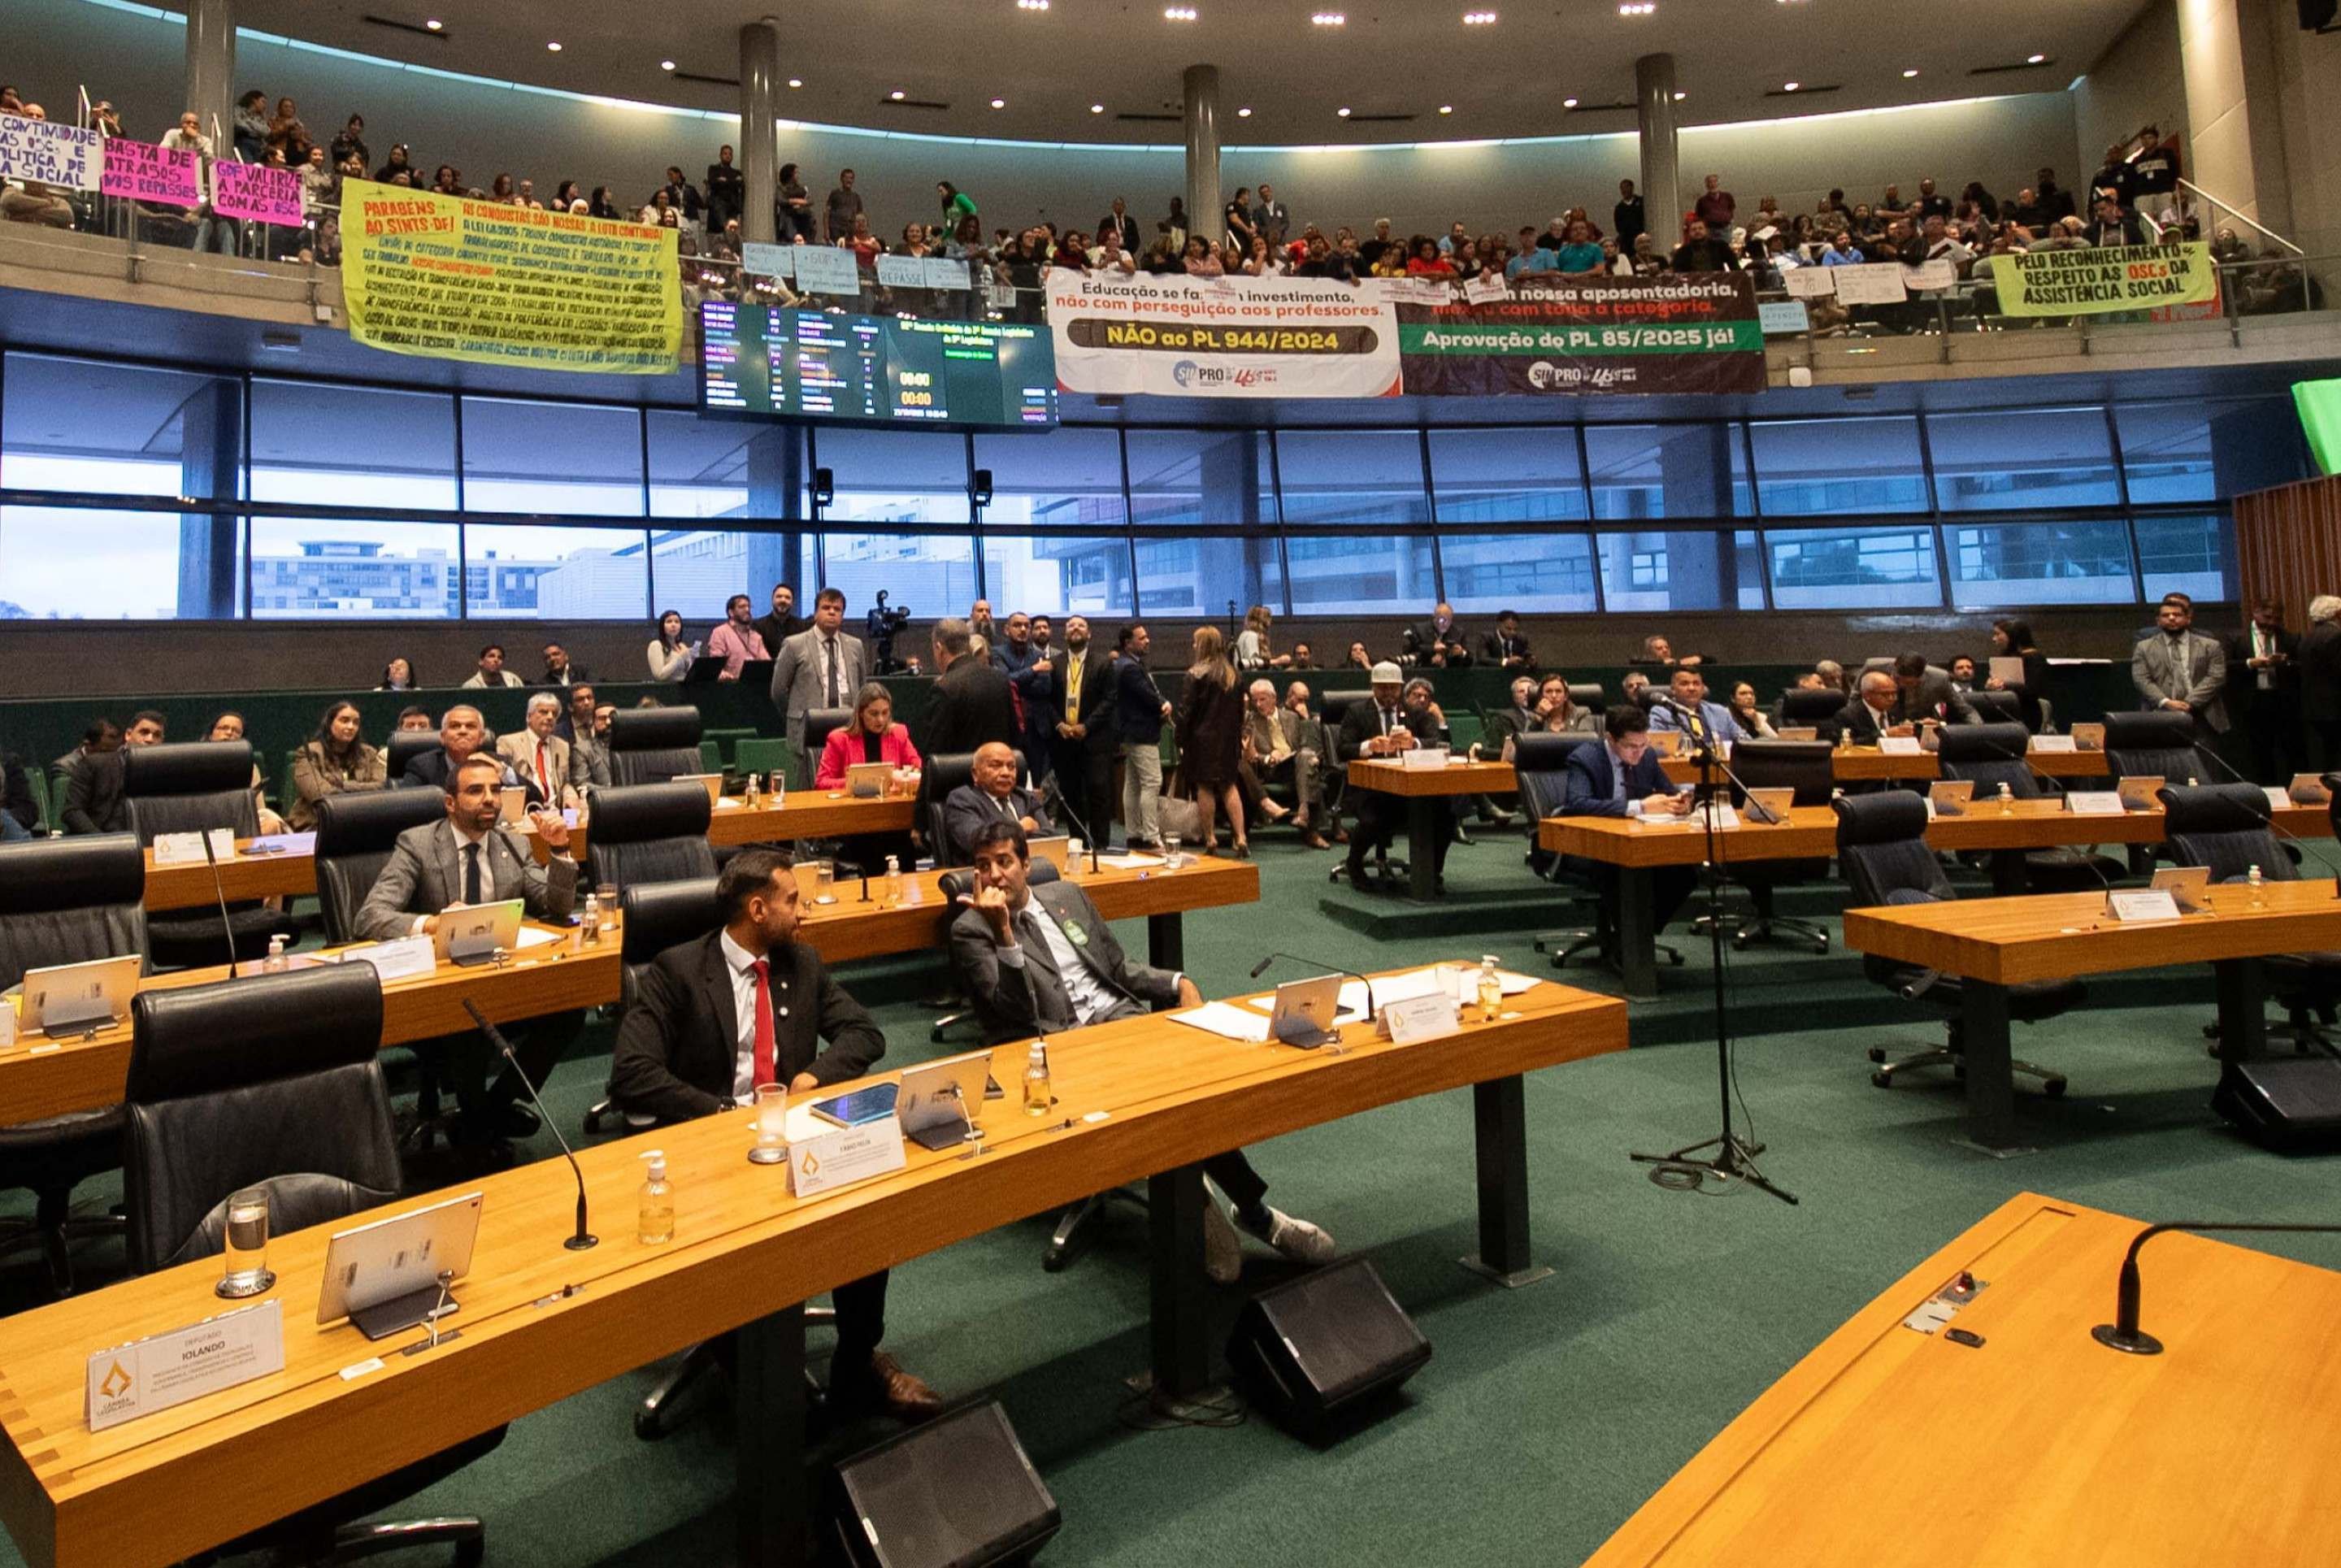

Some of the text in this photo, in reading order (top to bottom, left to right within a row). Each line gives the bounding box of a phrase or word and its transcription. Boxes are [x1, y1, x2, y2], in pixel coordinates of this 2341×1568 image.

[2, 117, 97, 146] CONTINUIDADE
[75, 145, 85, 158] E
[105, 138, 192, 167] BASTA DE
[21, 163, 85, 186] SOCIAL
[67, 159, 85, 173] DE
[105, 156, 182, 183] ATRASOS
[217, 162, 242, 178] GDF
[105, 174, 197, 199] NOS REPASSES
[218, 178, 300, 203] A PARCERIA
[218, 194, 247, 210] COM
[250, 198, 268, 212] AS
[366, 219, 384, 235] AO
[476, 206, 531, 224] CONQUISTAS
[554, 215, 585, 232] NOSSAS
[2014, 254, 2046, 270] PELO
[2049, 244, 2181, 268] RECONHECIMENTO
[881, 271, 923, 284] REPASSE
[2024, 259, 2190, 286] RESPEITO AS OSCs DA
[1082, 282, 1157, 299] Educação
[1163, 289, 1179, 299] se
[1184, 287, 1203, 300] fa
[1248, 290, 1354, 303] investimento,
[1520, 288, 1578, 301] nossa
[1582, 282, 1738, 304] aposentadoria,
[2128, 277, 2185, 298] SOCIAL
[1056, 293, 1383, 319] não com perseguição aos professores.
[1500, 304, 1539, 315] com
[1596, 304, 1609, 315] a
[1614, 299, 1717, 318] categoria.
[1107, 323, 1339, 350] NÃO ao PL 944/2024
[1423, 328, 1734, 350] Aprovação do PL 85/2025 já!
[901, 391, 932, 406] 00:00
[182, 1340, 225, 1361] IOLANDO
